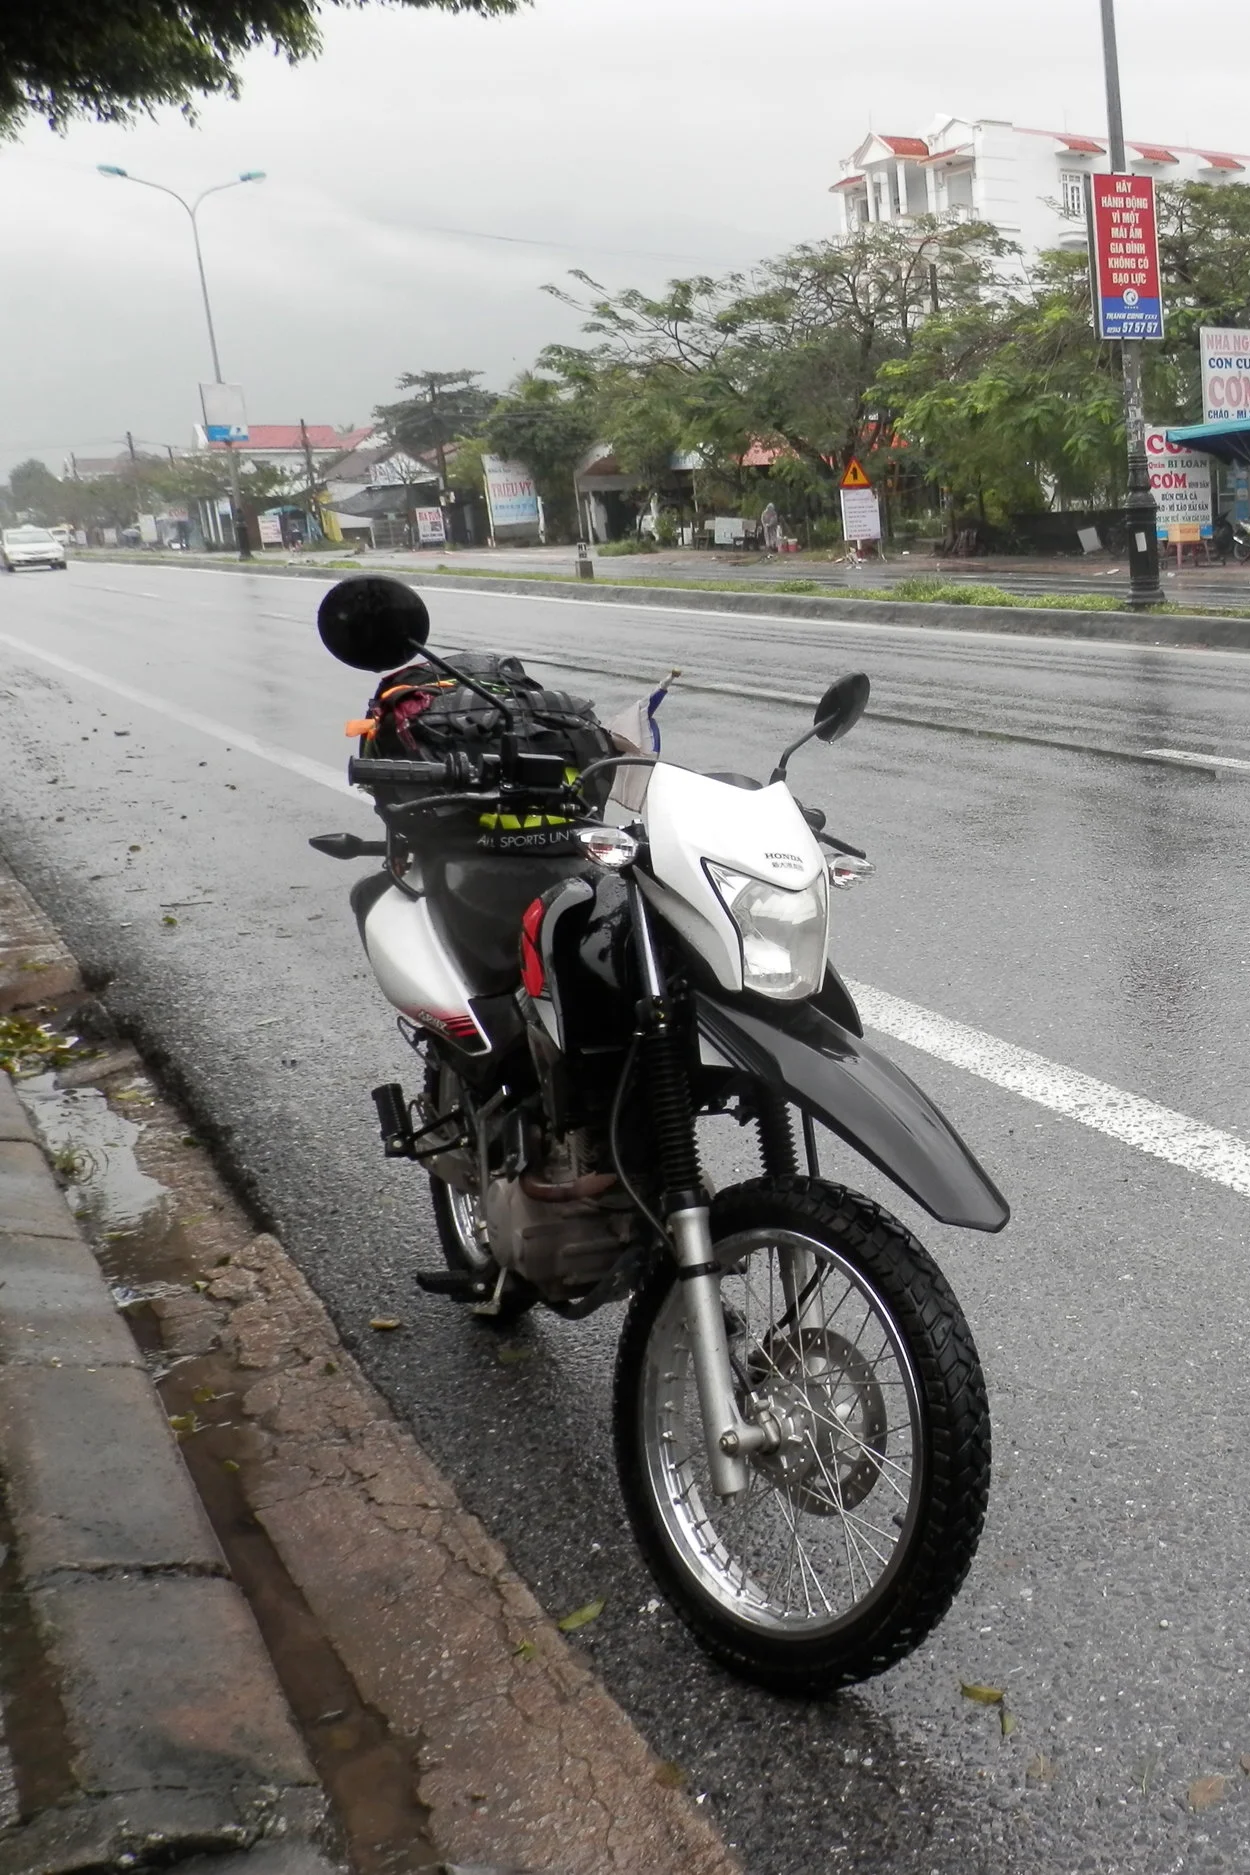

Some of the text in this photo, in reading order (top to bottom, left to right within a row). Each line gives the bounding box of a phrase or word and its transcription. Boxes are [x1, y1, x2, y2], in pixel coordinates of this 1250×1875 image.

[1101, 194, 1148, 211] HÀNH ĐỘNG
[1112, 210, 1139, 225] VÌ MỘT
[1111, 225, 1127, 238] MÁI
[1110, 241, 1145, 254] GIA ĐÌNH
[1108, 256, 1149, 269] KHÔNG CÓ
[1112, 272, 1146, 286] BẠO LỰC
[1208, 357, 1232, 369] CON
[1150, 471, 1187, 489] CƠM
[500, 833, 546, 848] SPORTS
[764, 852, 804, 863] HONDA
